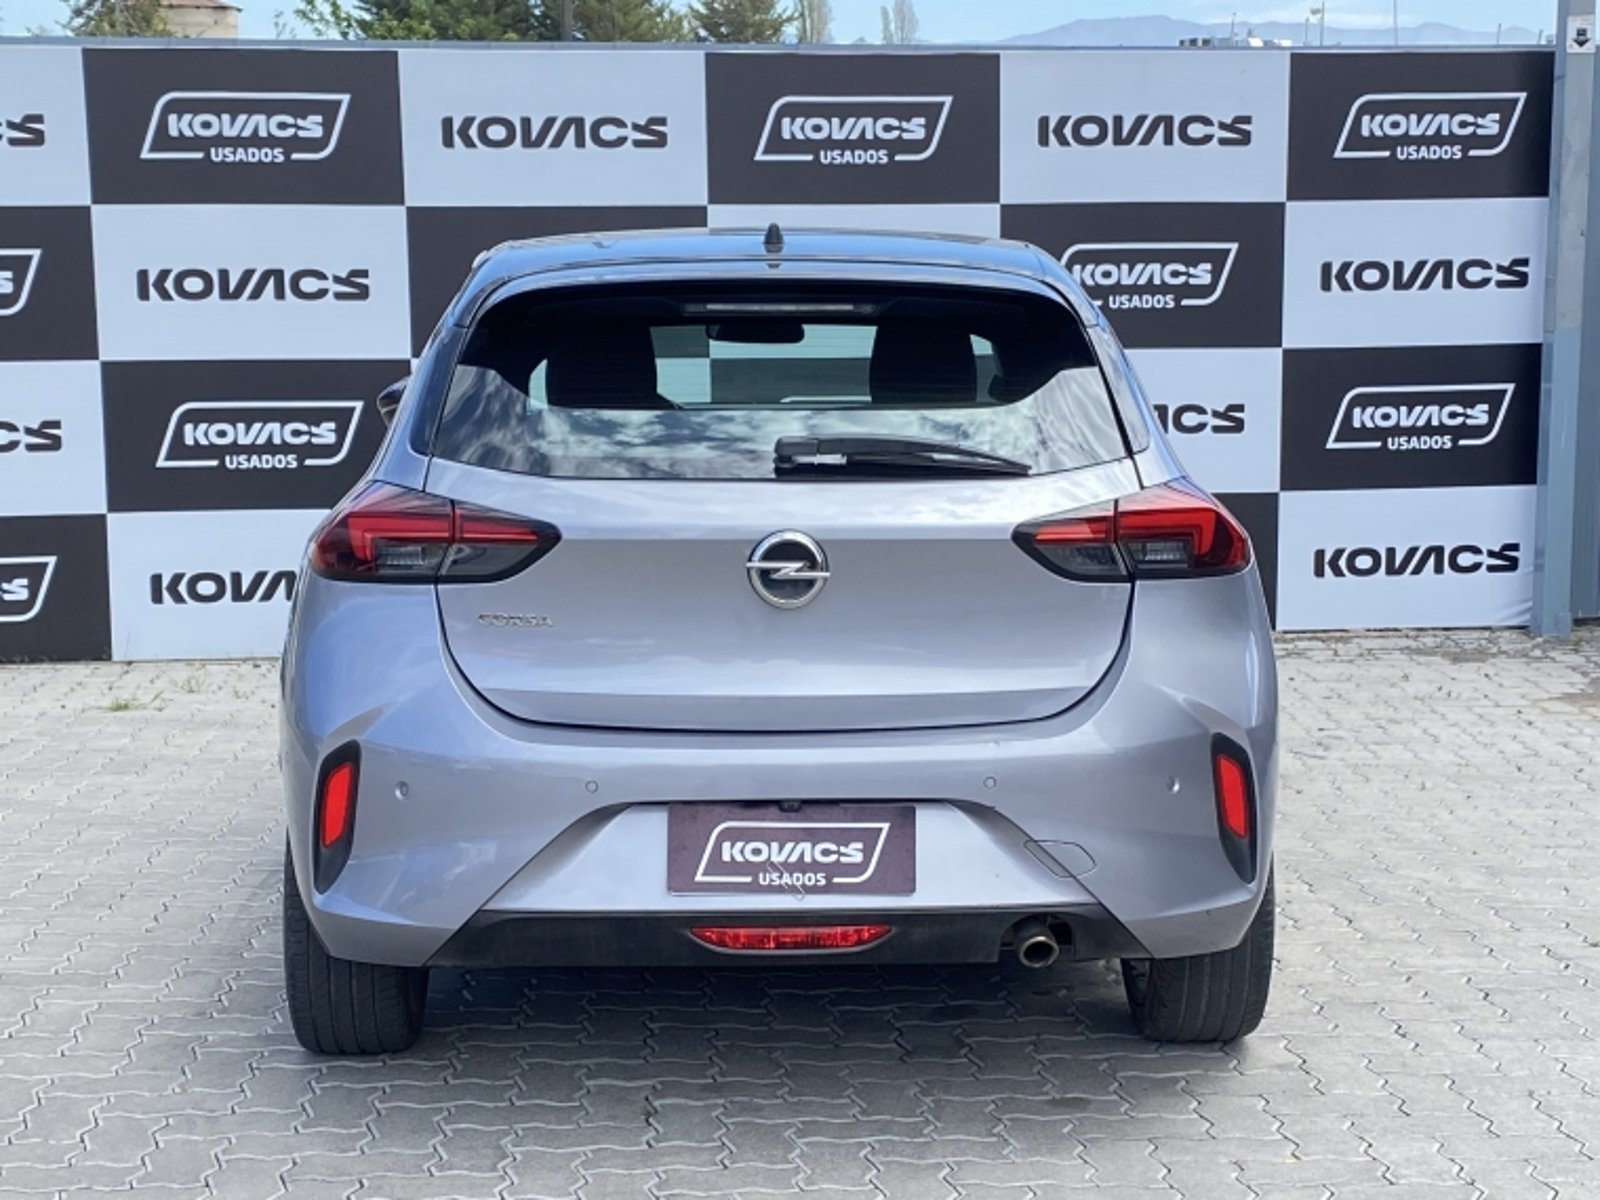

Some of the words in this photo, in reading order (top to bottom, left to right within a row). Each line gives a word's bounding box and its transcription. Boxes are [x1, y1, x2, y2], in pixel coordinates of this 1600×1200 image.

[168, 113, 323, 138] KOVACS
[442, 115, 668, 149] KOVACS
[781, 117, 926, 140] KOVACS
[1037, 115, 1252, 147] KOVACS
[1361, 113, 1500, 137] KOVACS
[210, 147, 285, 163] USADOS
[820, 150, 889, 164] USADOS
[1397, 145, 1462, 160] USADOS
[137, 268, 370, 302] KOVACS
[1072, 263, 1212, 286] KOVACS
[1321, 257, 1530, 293] KOVACS
[1109, 294, 1175, 308] USADOS
[1352, 404, 1490, 428] KOVACS
[183, 422, 337, 446] KOVACS
[1387, 436, 1452, 450] USADOS
[225, 454, 298, 469] USADOS
[1314, 542, 1521, 578] KOVACS
[721, 841, 864, 864] KOVACS
[759, 872, 827, 887] USADOS
